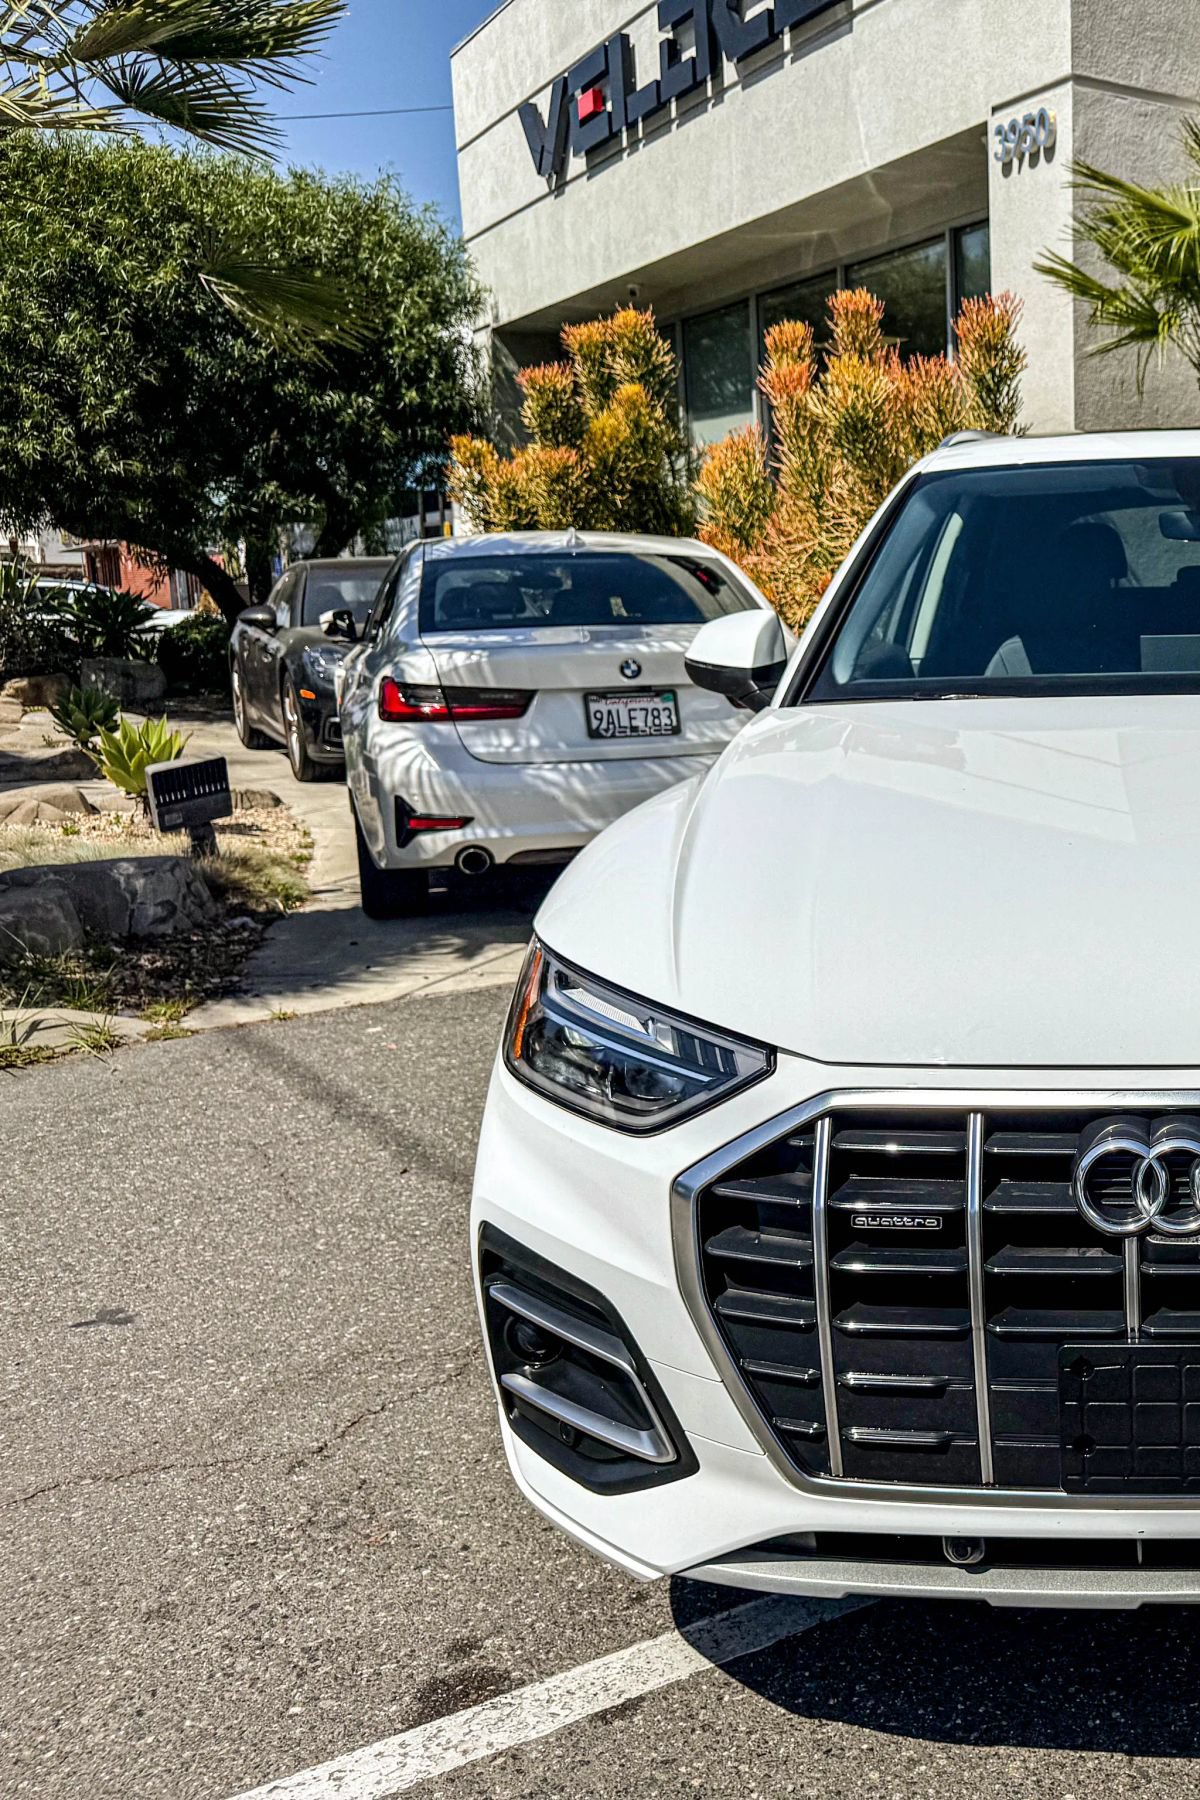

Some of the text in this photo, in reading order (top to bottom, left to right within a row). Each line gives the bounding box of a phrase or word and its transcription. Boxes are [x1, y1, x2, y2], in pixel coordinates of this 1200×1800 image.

[994, 107, 1048, 161] 3950
[593, 707, 673, 732] 9ALE783
[854, 1216, 938, 1227] quattro
